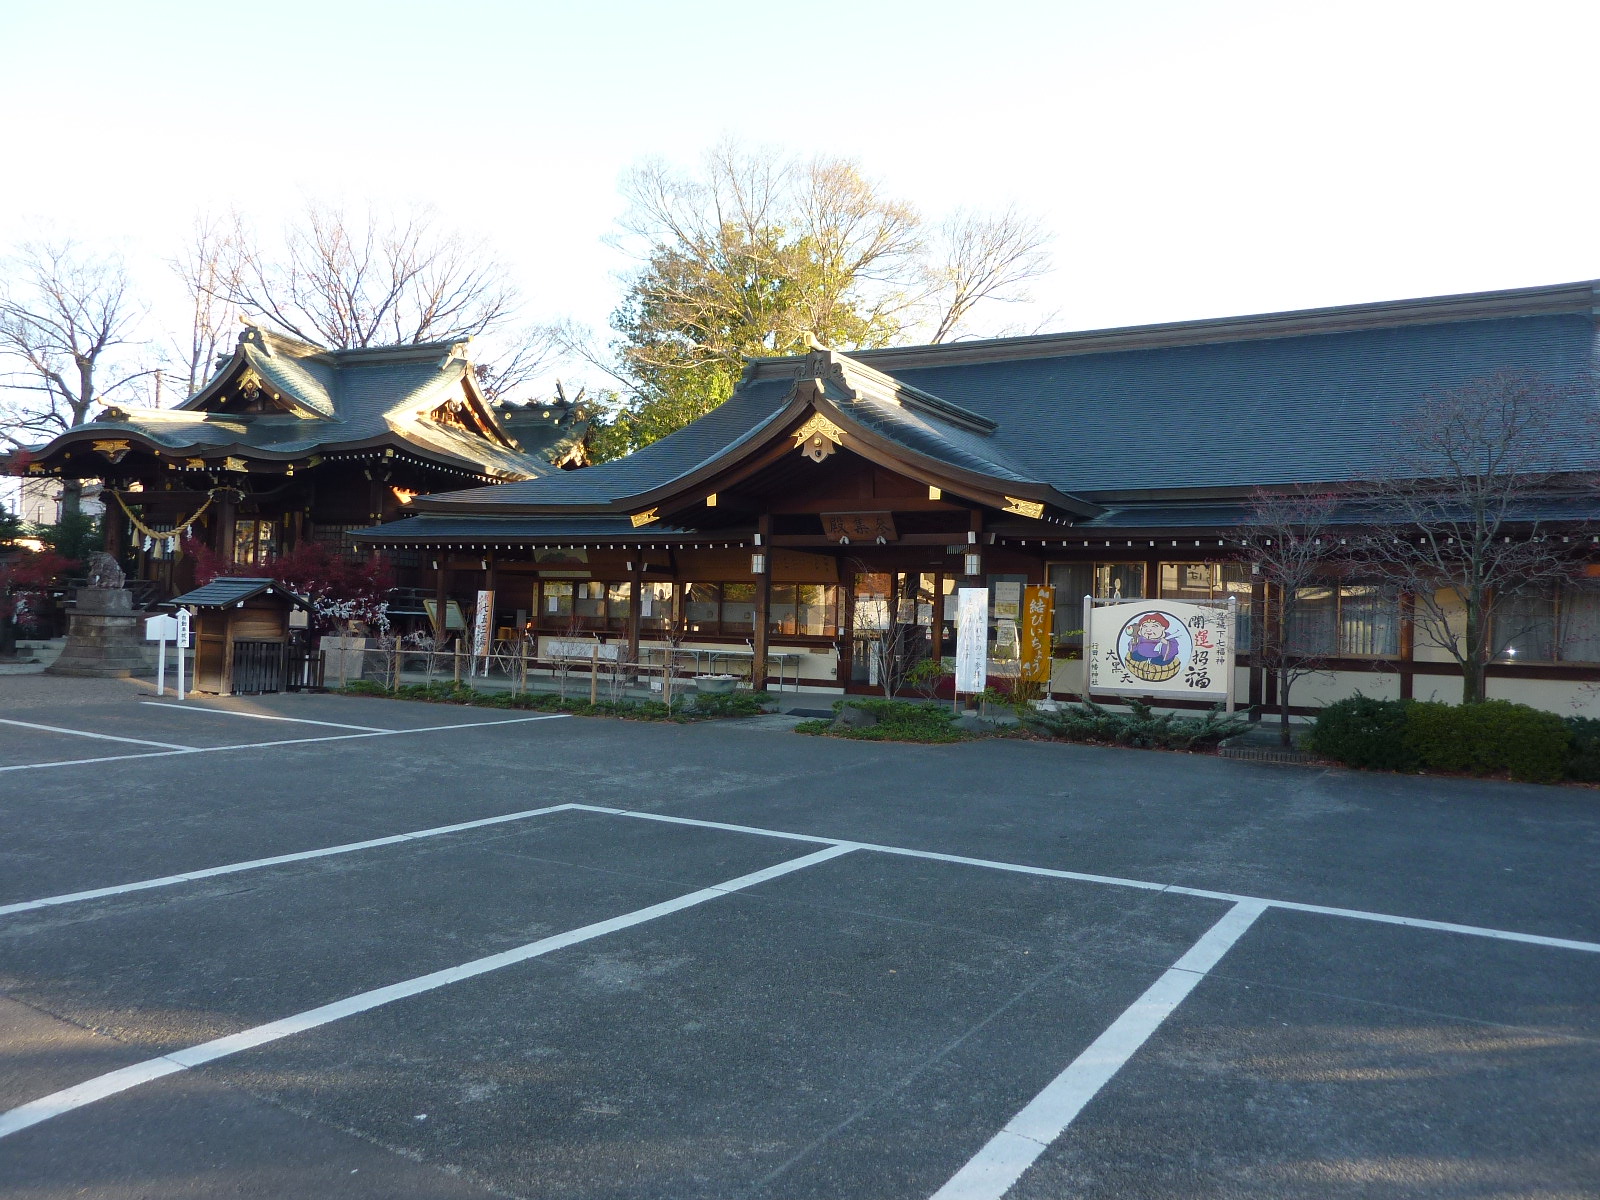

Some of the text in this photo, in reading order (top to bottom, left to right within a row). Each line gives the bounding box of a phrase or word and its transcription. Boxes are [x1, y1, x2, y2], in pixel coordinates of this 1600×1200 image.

[1029, 599, 1046, 674] 結びいちょう
[1091, 642, 1099, 686] 行田八幡神社
[1106, 649, 1133, 683] 大黒天
[1185, 615, 1214, 689] 開運招福
